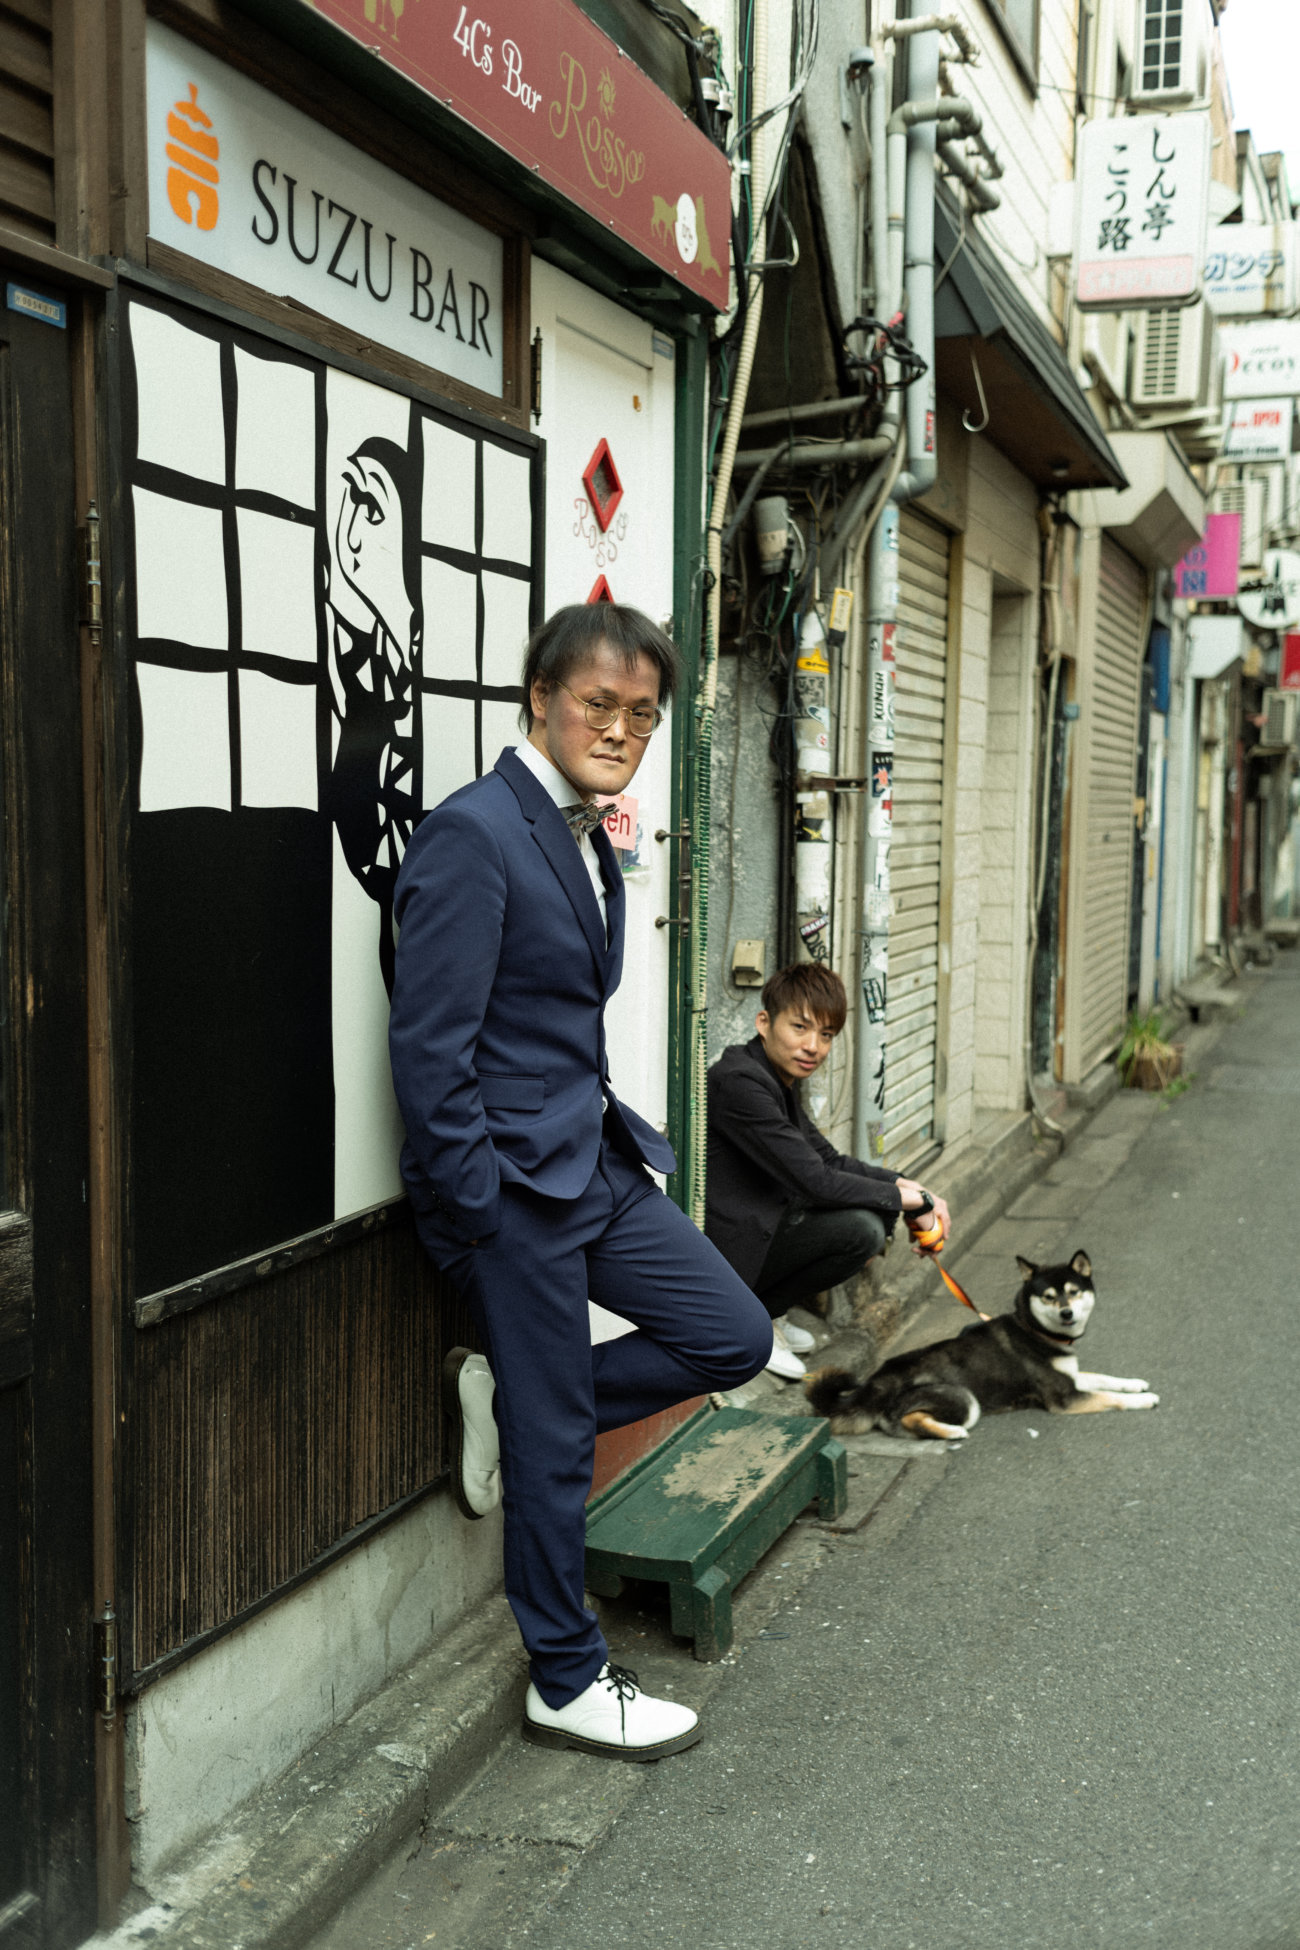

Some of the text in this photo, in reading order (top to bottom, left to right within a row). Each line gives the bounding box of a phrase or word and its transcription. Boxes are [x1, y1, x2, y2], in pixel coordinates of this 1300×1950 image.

[453, 5, 543, 114] 4C's Bar
[549, 51, 646, 198] Rosso
[1098, 144, 1133, 251] こう路
[1142, 127, 1176, 241] しん亭
[251, 159, 493, 358] SUZU BAR
[601, 811, 631, 837] en
